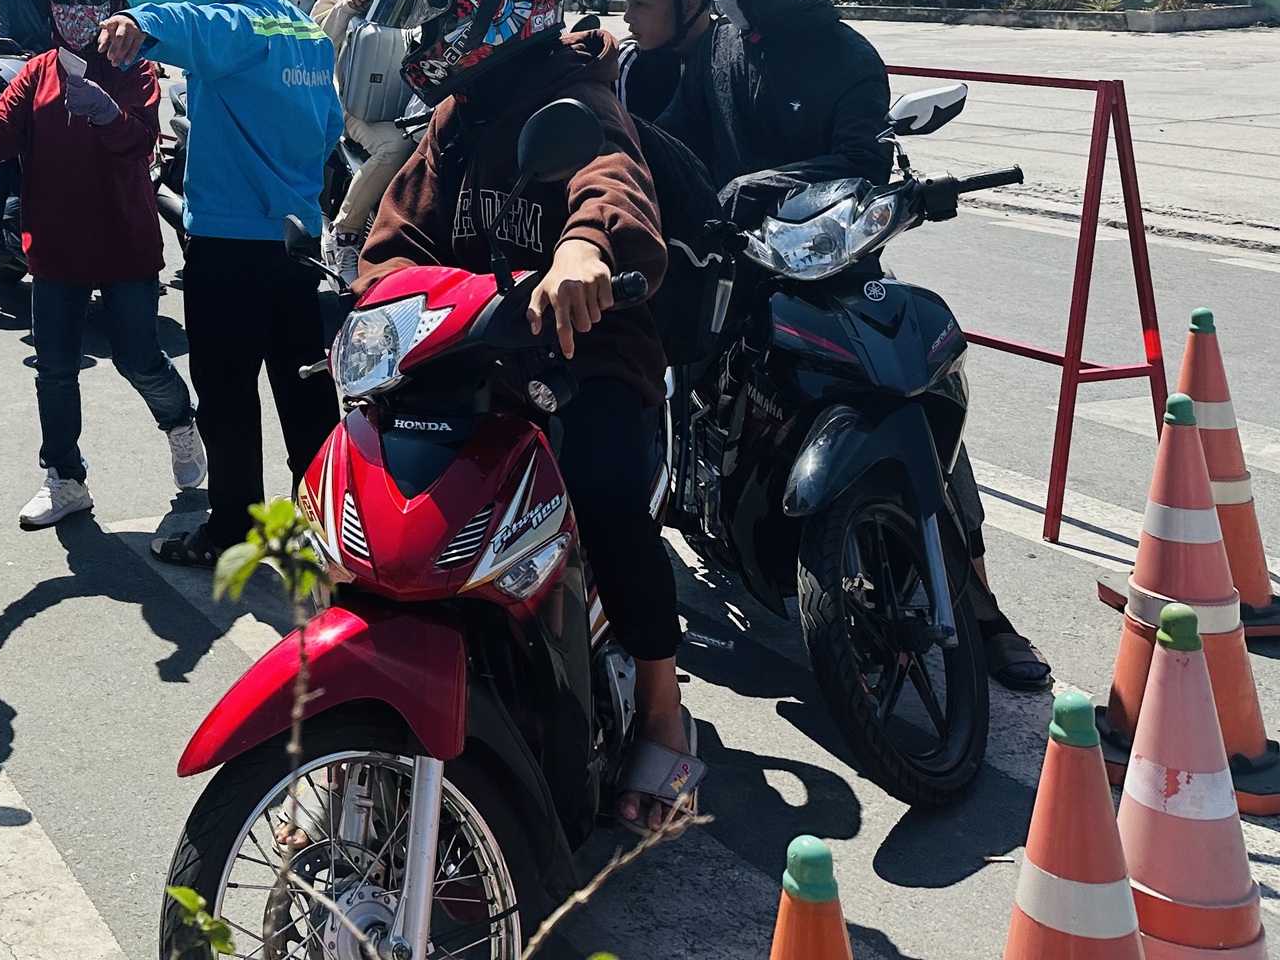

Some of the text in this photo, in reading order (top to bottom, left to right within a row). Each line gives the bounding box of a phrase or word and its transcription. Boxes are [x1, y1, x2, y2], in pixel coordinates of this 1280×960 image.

[746, 382, 783, 421] YAMAHA
[394, 419, 453, 432] HONDA
[300, 494, 317, 523] 125
